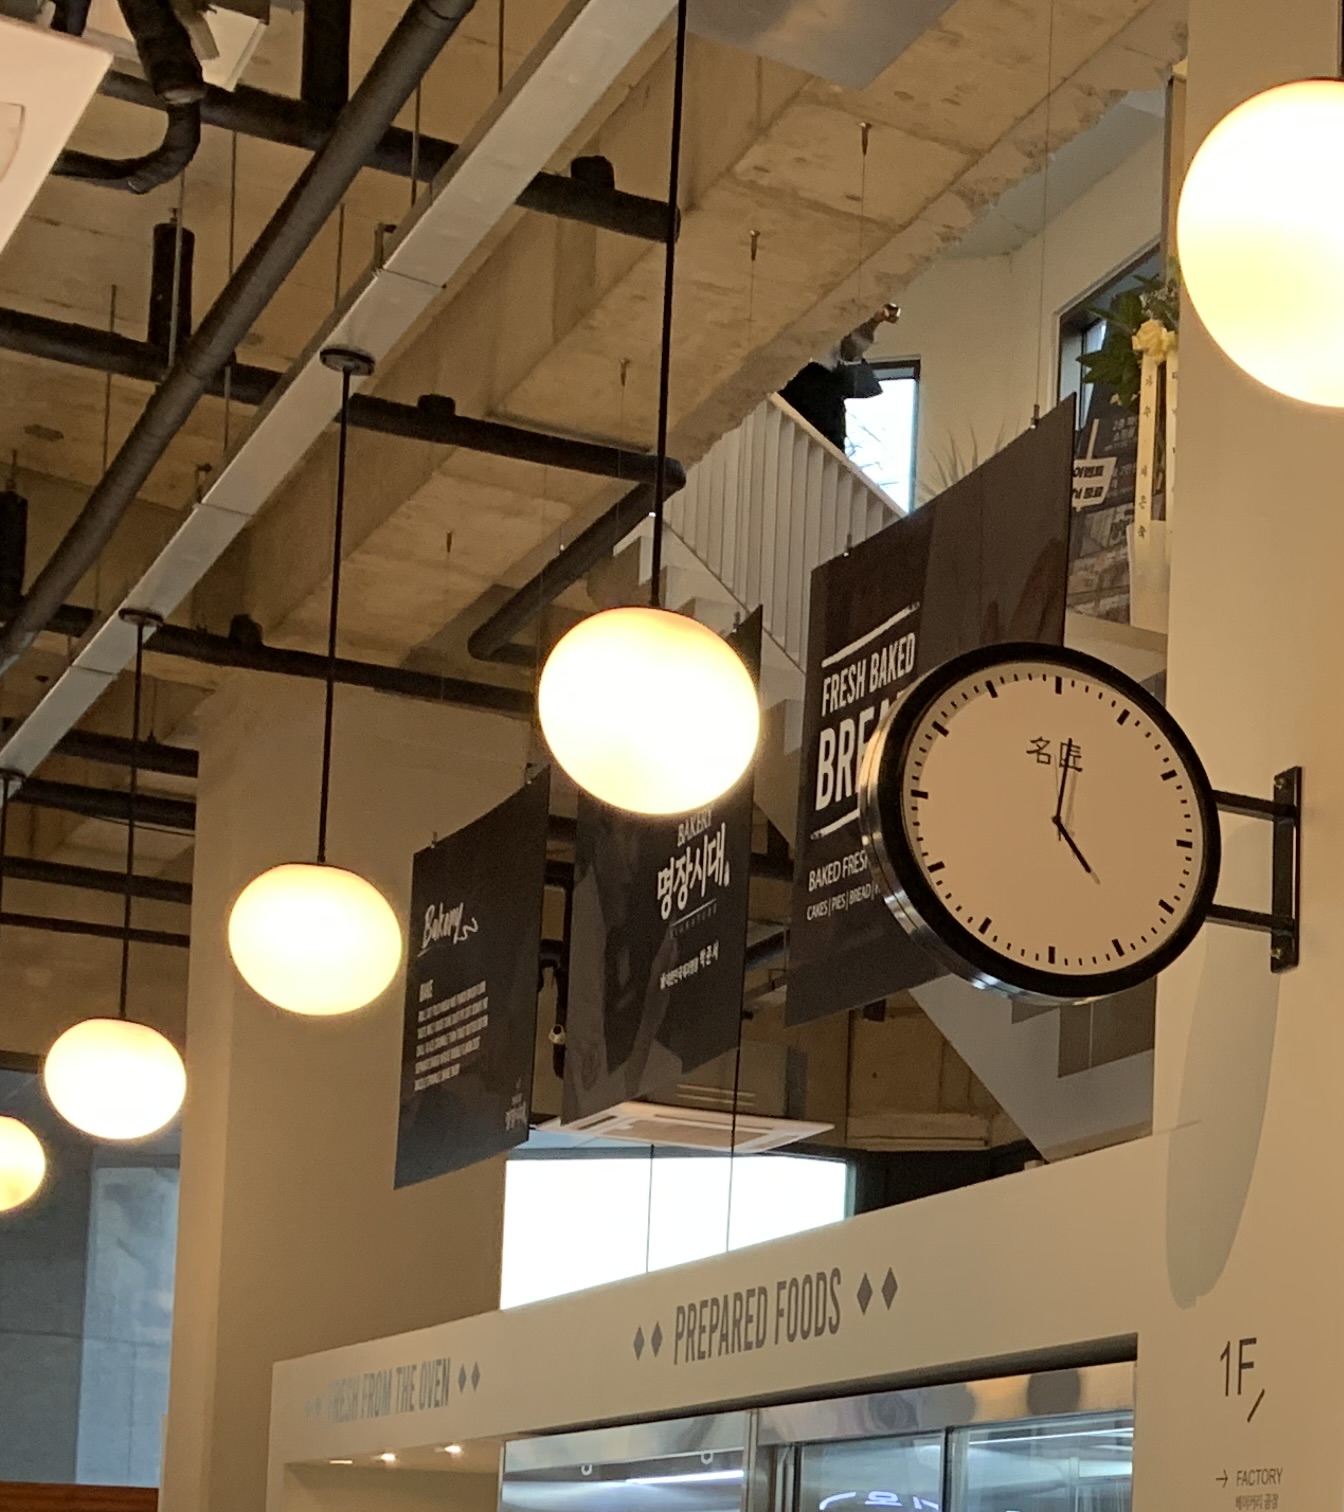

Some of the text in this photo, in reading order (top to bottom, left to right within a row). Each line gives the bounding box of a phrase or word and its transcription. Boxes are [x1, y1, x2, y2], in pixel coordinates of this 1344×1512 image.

[821, 632, 916, 717] FRESH BAKED
[815, 690, 905, 811] BRE
[806, 884, 872, 921] CAKES PIES BREAD
[808, 857, 842, 892] BAKED
[673, 1266, 842, 1366] PREPARED FOODS
[361, 1368, 392, 1420] FROM
[396, 1364, 416, 1414] THE
[418, 1357, 451, 1411] OVEN
[1235, 1467, 1284, 1487] FACTORY
